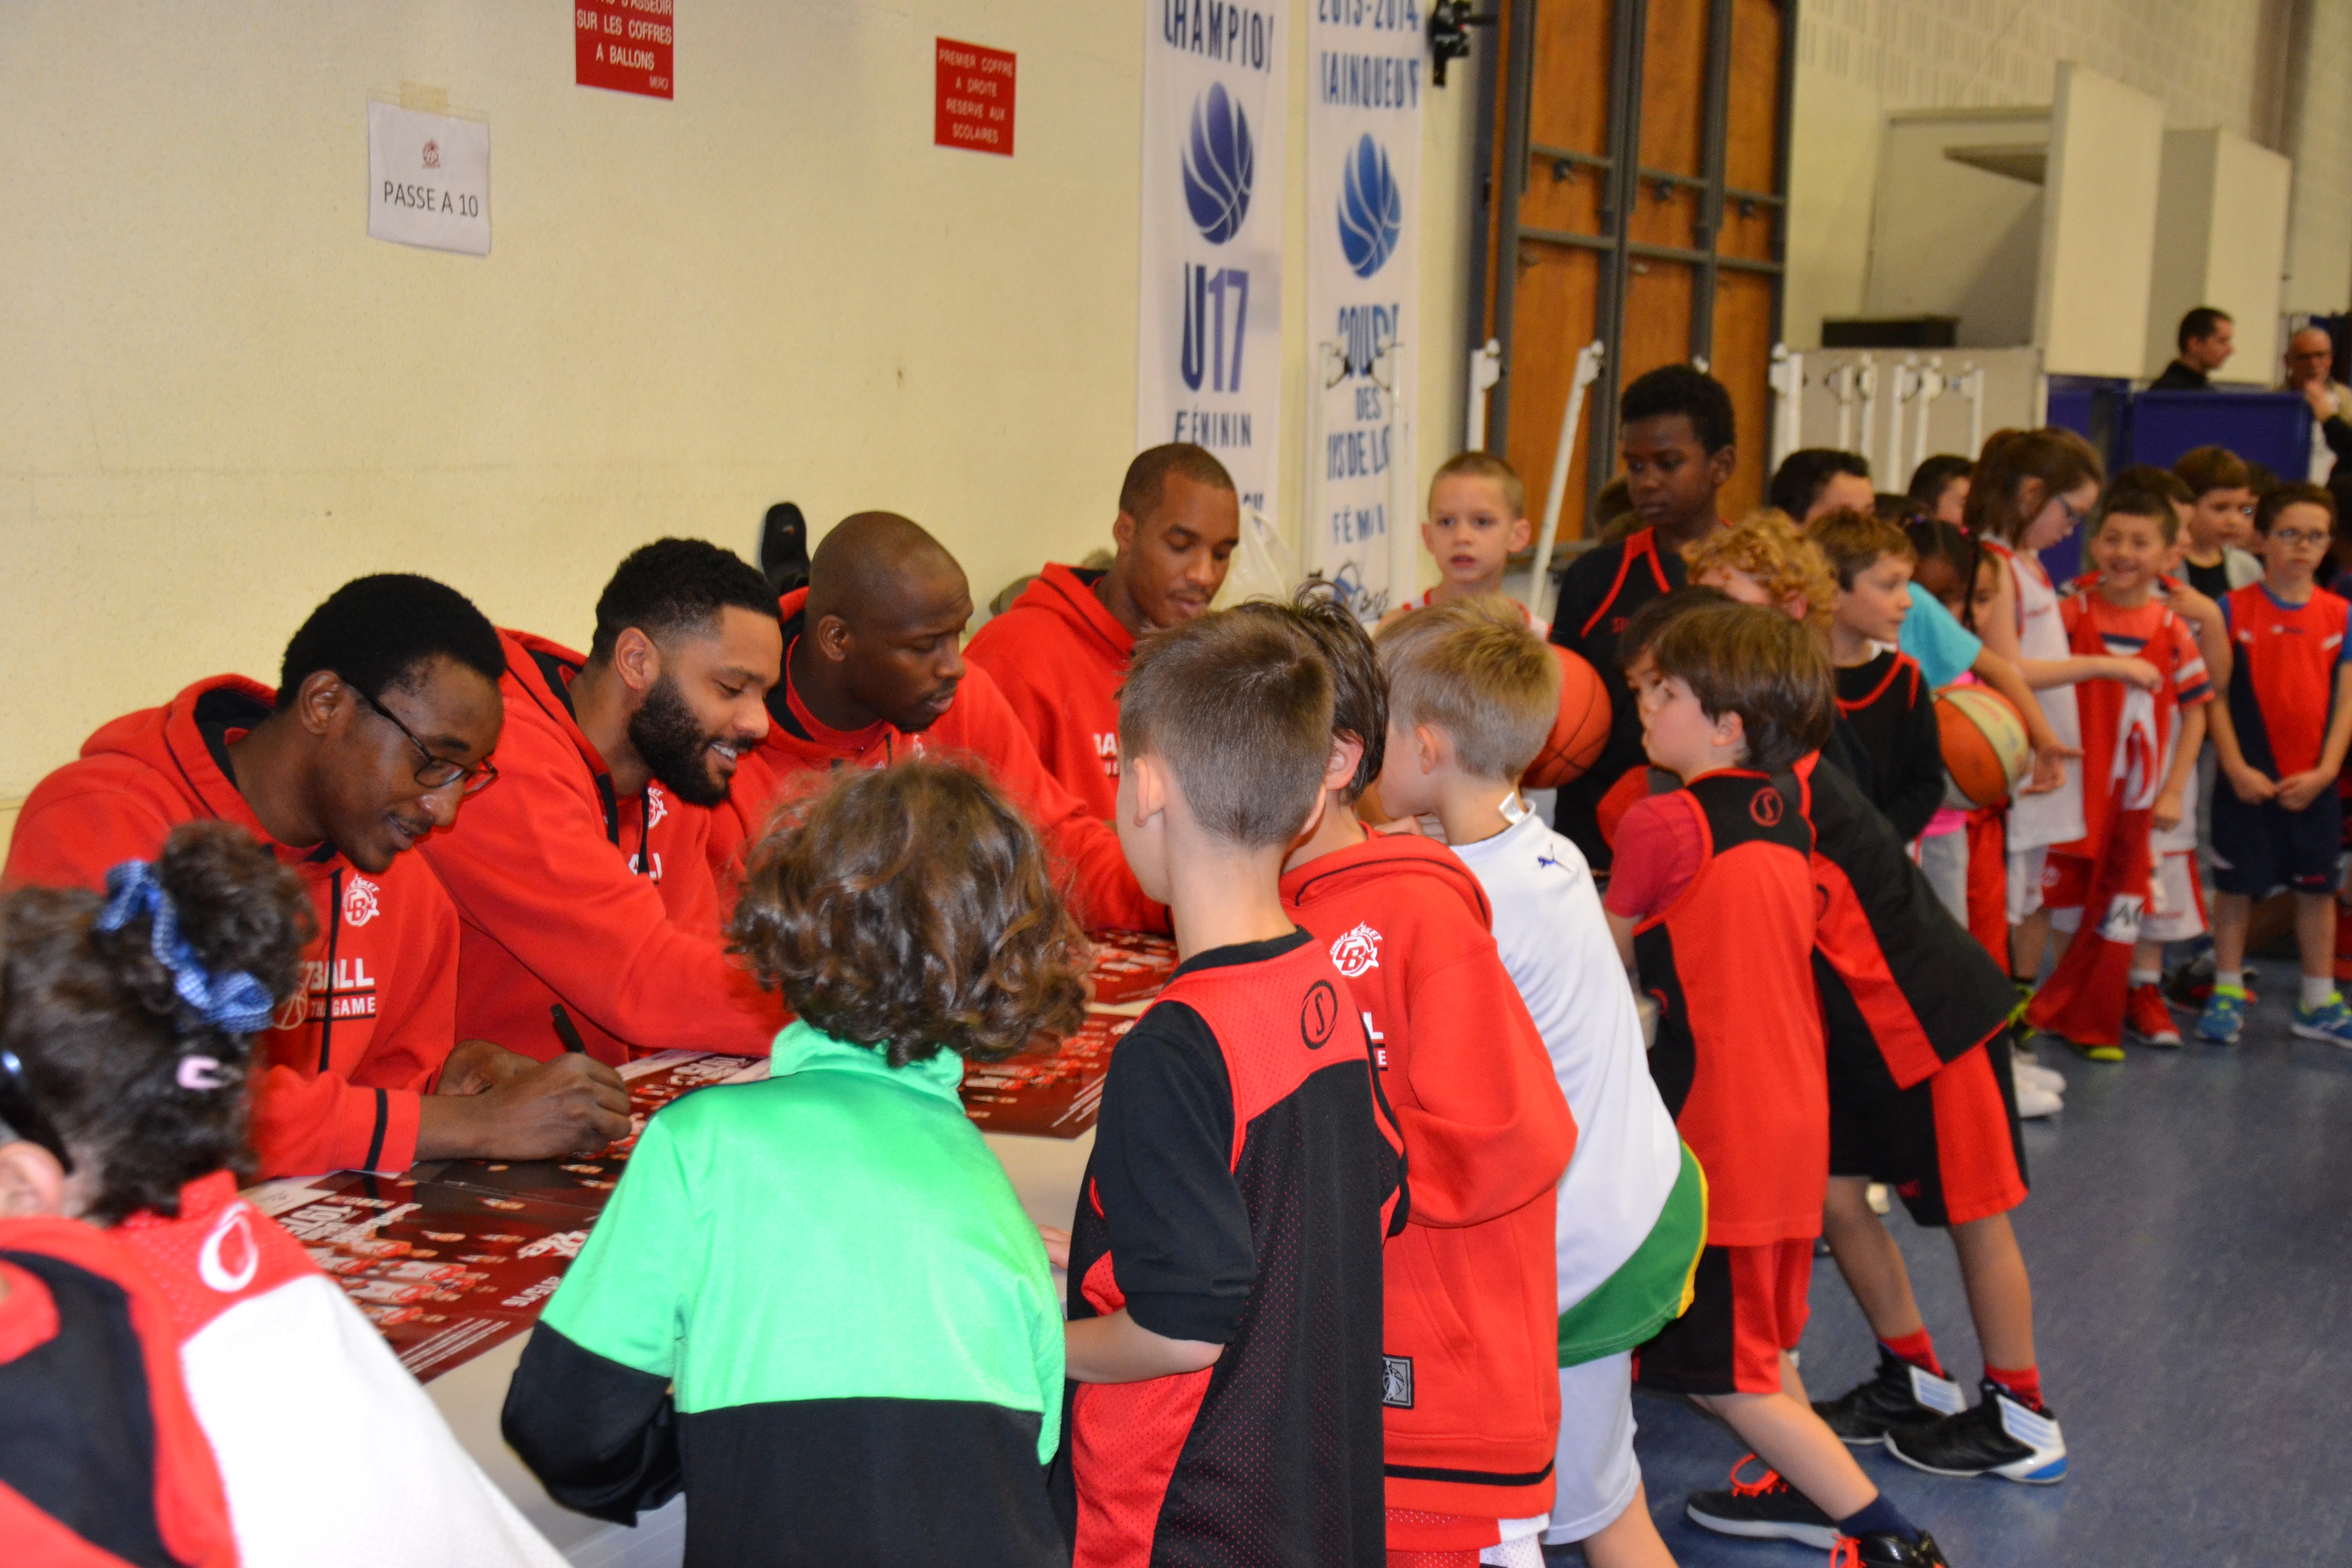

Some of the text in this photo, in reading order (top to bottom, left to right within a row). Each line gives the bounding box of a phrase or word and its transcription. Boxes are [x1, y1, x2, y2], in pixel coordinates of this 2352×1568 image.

[577, 9, 672, 45] SUR LES COFFRES
[596, 43, 654, 71] A BALLONS
[939, 49, 1013, 78] PREMIER COFFRE
[952, 122, 999, 144] SCOLAIRES
[384, 180, 478, 218] PASSE A 10
[1182, 262, 1248, 393] U17
[333, 996, 376, 1017] GAME
